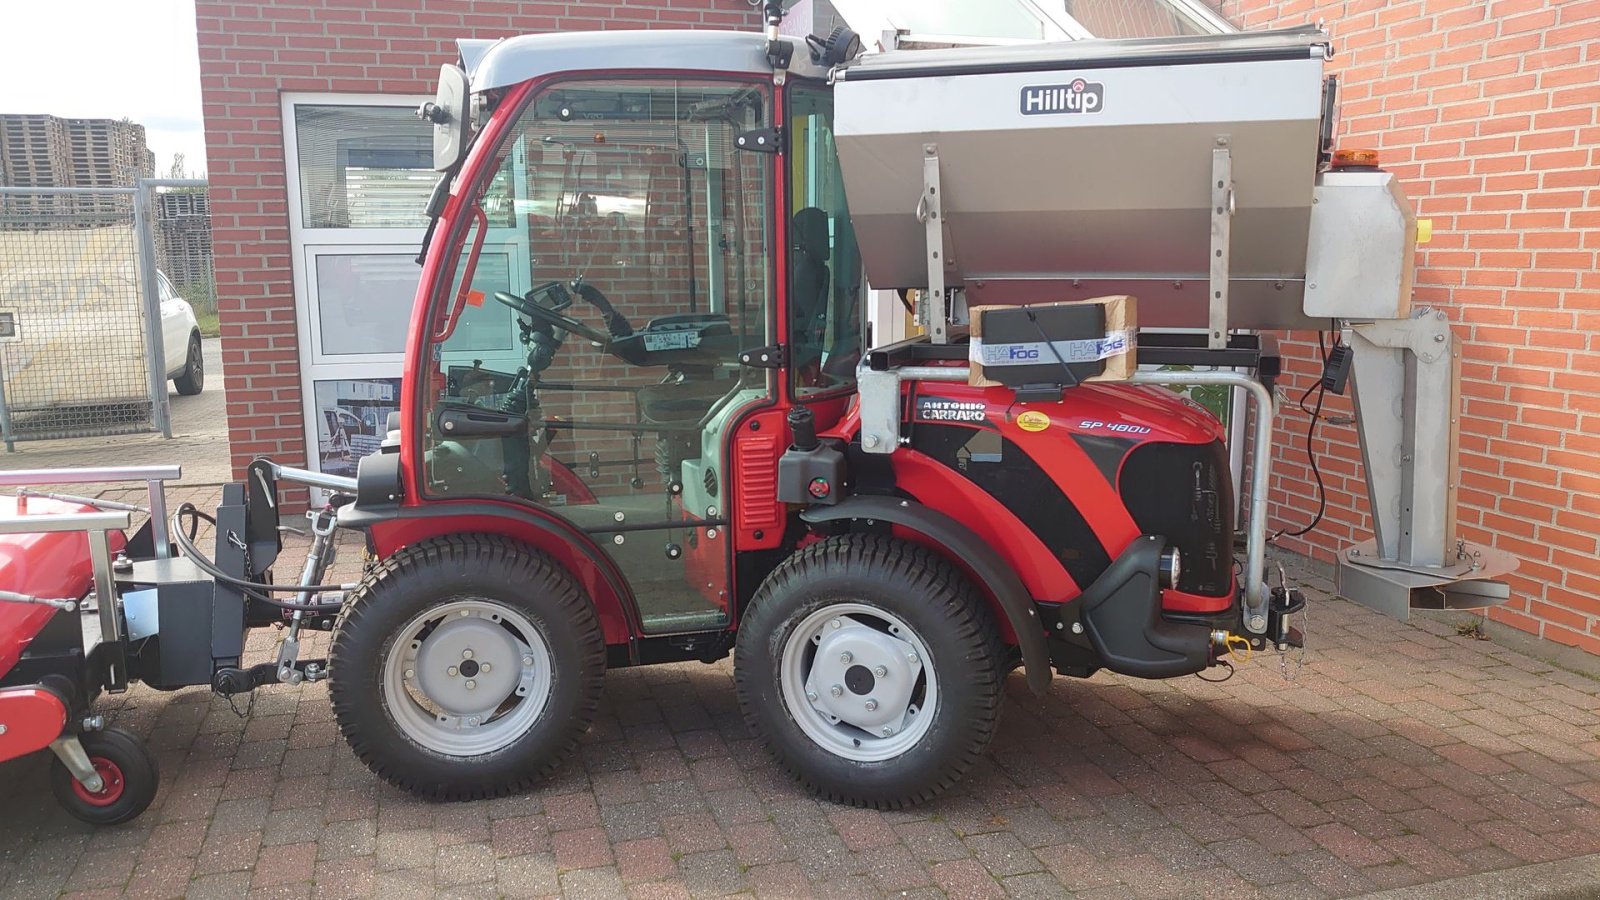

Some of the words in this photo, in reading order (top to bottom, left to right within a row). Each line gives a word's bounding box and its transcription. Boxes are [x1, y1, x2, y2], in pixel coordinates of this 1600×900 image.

[1026, 88, 1098, 114] Hilltip
[922, 410, 985, 421] CARRARO
[1079, 421, 1103, 430] SP
